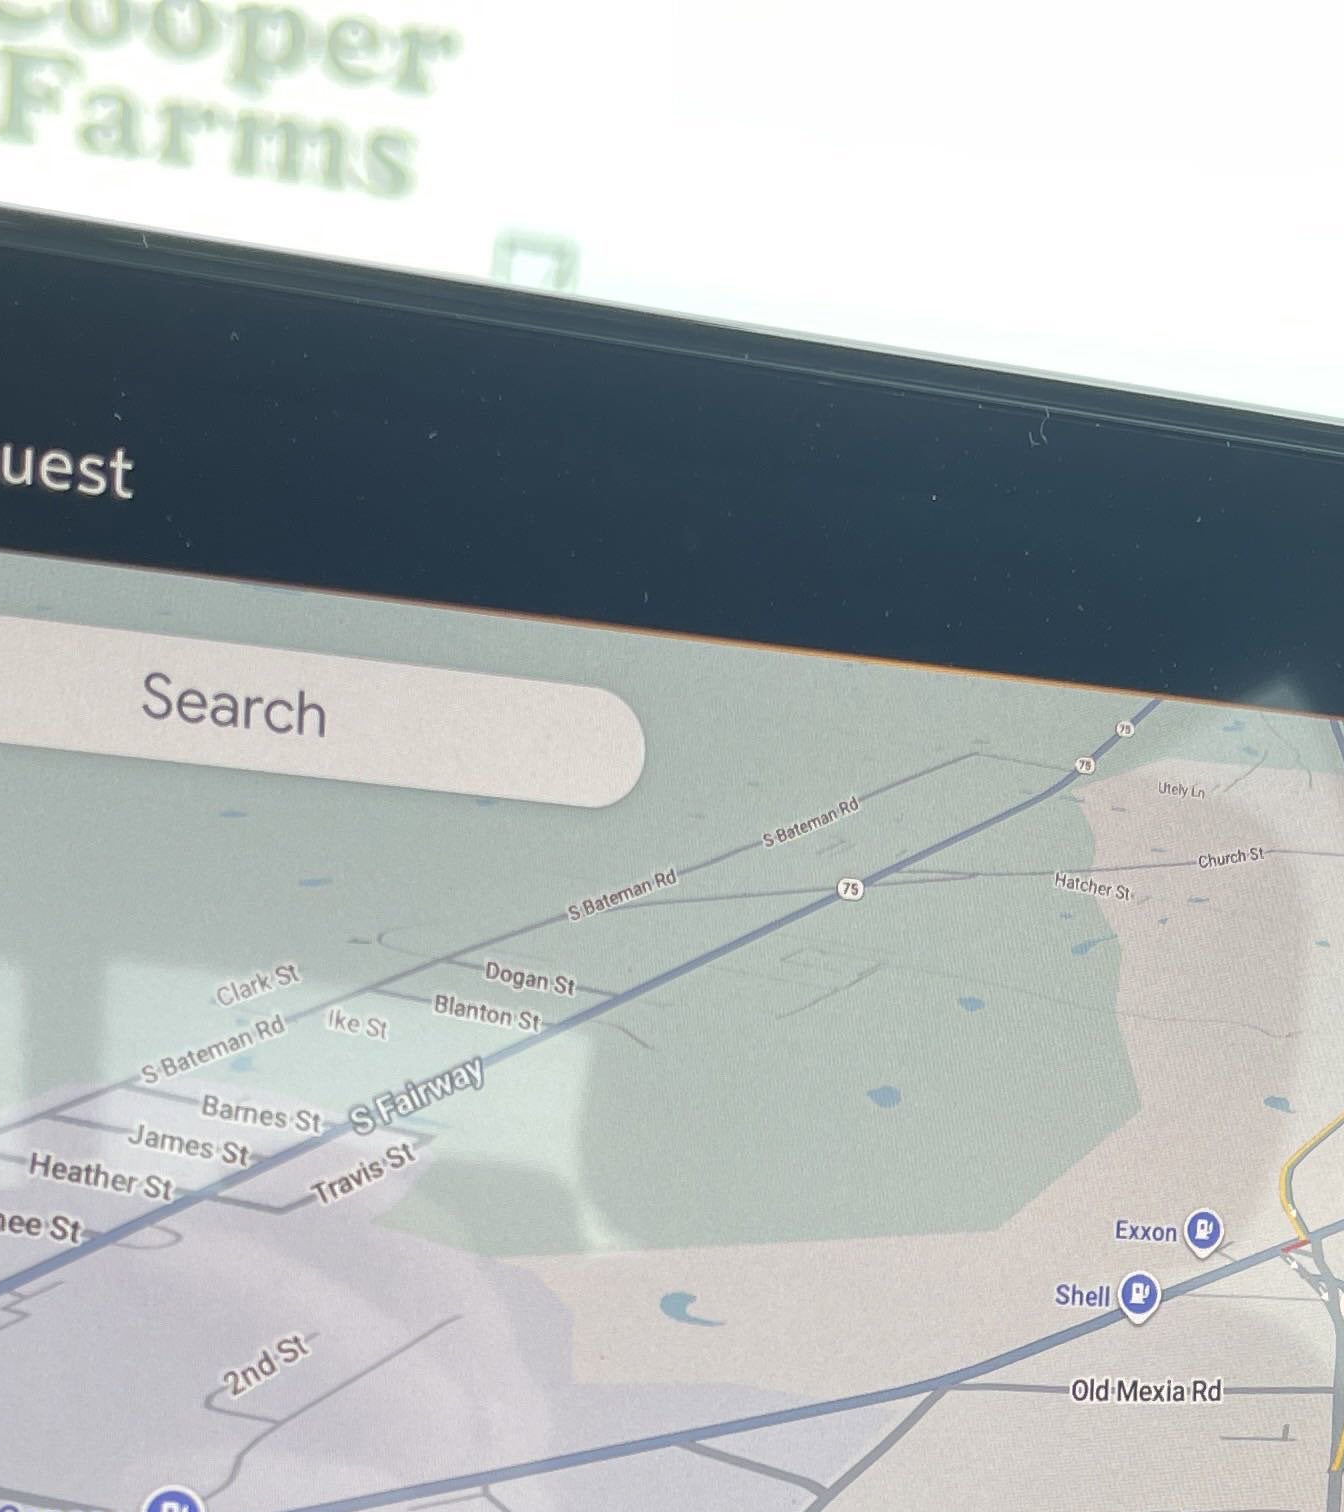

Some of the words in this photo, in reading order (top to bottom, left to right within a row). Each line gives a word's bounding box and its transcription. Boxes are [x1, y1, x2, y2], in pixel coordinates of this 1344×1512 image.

[142, 672, 326, 739] Search
[1190, 786, 1206, 799] Ln
[762, 832, 775, 848] S
[775, 807, 837, 843] Bateman
[837, 796, 860, 815] Rd
[1198, 849, 1246, 869] Church
[1248, 846, 1265, 862] St
[567, 905, 582, 922] S
[583, 880, 654, 917] Bateman
[654, 868, 678, 889] Rd
[842, 881, 860, 896] 75
[1055, 872, 1112, 897] Hatcher
[1115, 883, 1132, 900] St
[216, 972, 272, 1008] Clark
[274, 963, 301, 988] St
[486, 961, 548, 992] Dogan
[554, 974, 576, 996] St
[328, 1009, 362, 1033] Ike
[366, 1017, 389, 1041] St
[434, 995, 512, 1029] Blanton
[517, 1009, 543, 1033] St
[141, 1064, 159, 1085] S
[161, 1029, 253, 1079] Bateman
[256, 1014, 286, 1041] Rd
[202, 1095, 287, 1130] Barnes
[295, 1110, 323, 1135] St
[349, 1105, 375, 1136] S
[375, 1057, 486, 1126] Fairway
[128, 1124, 215, 1160] James
[221, 1141, 250, 1167] St
[29, 1151, 136, 1194] Heather
[143, 1175, 173, 1201] St
[310, 1156, 384, 1205] Travis
[384, 1141, 417, 1172] St
[49, 1215, 82, 1244] St
[1115, 1219, 1178, 1243] Exxon
[1055, 1283, 1111, 1308] Shell
[223, 1352, 276, 1398] 2nd
[276, 1334, 310, 1366] St
[1071, 1380, 1112, 1403] Old
[1117, 1380, 1186, 1403] Mexia
[1190, 1379, 1224, 1403] Rd
